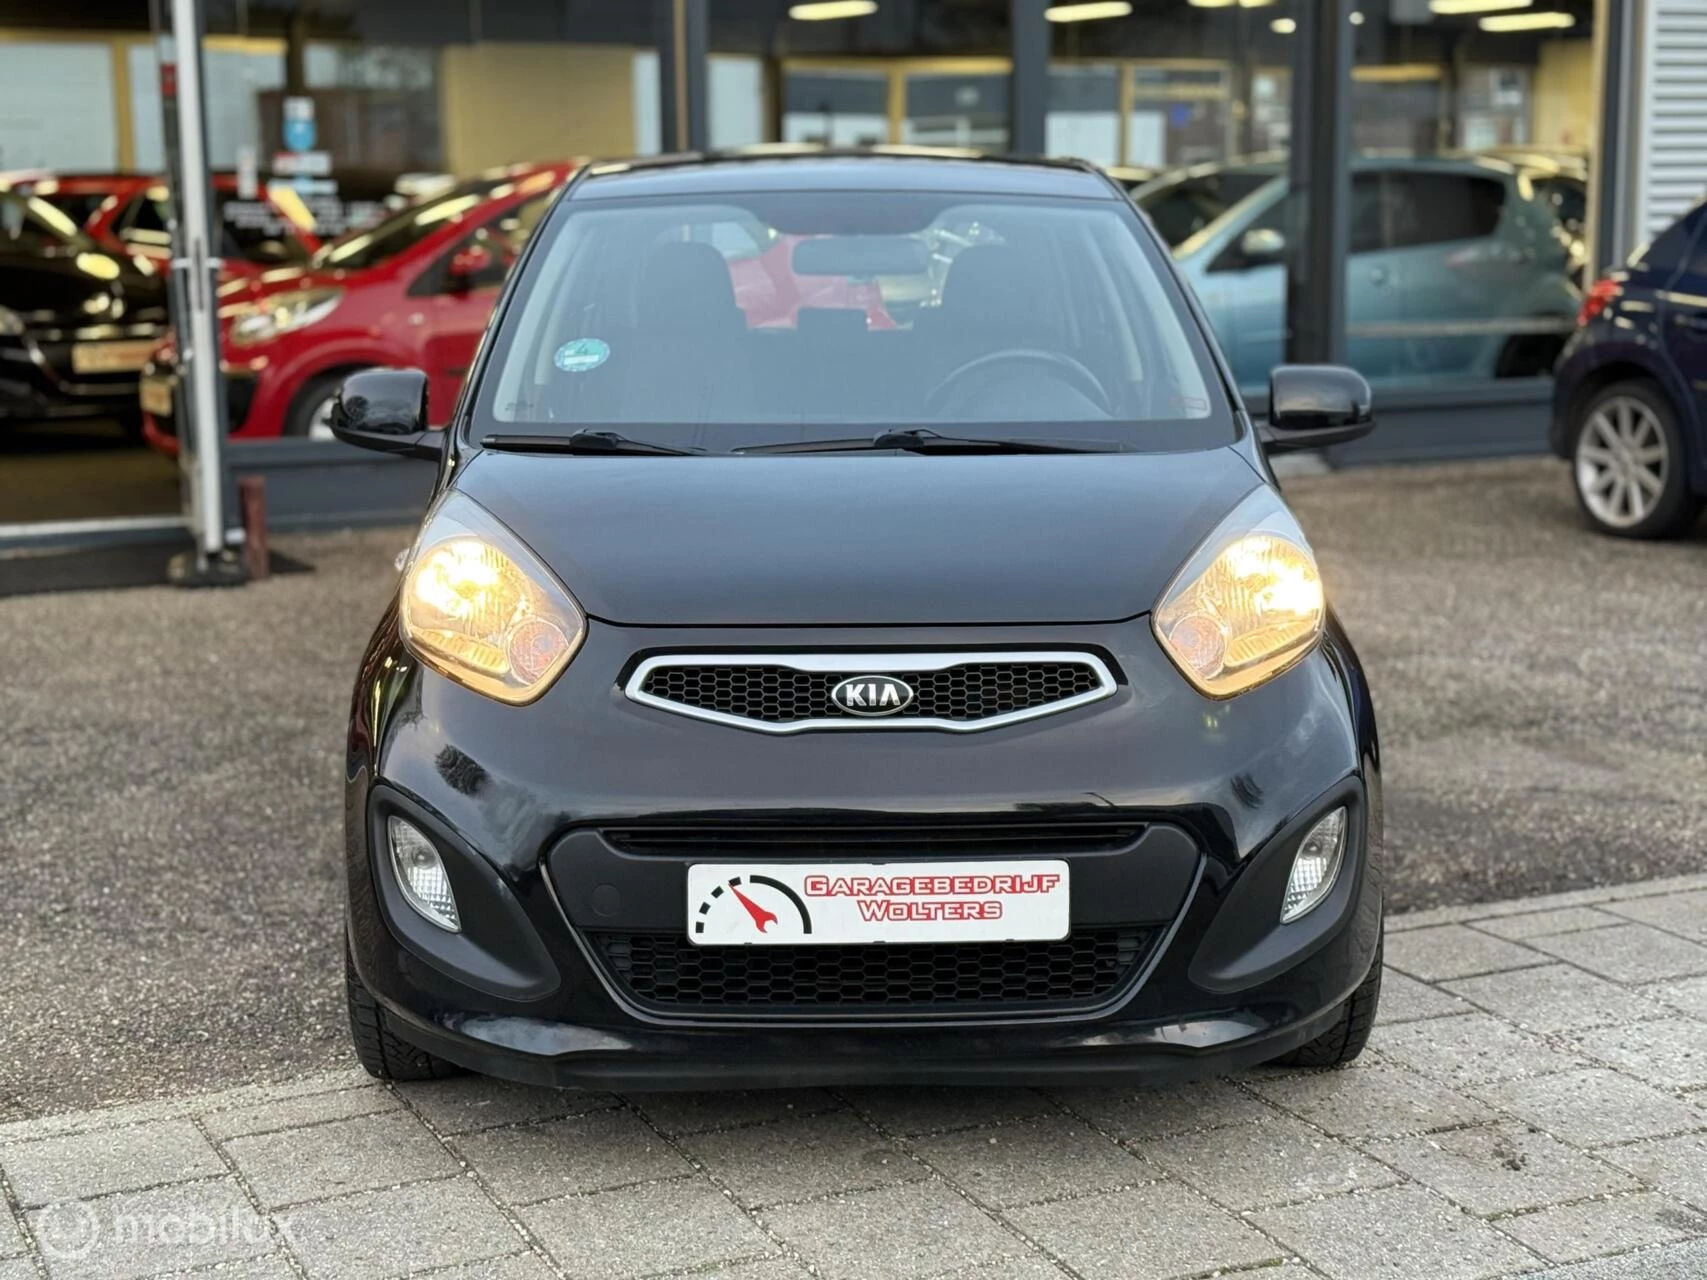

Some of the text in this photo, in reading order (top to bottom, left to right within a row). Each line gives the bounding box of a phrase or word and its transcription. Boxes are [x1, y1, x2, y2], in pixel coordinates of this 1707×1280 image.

[845, 683, 901, 706] KIA
[804, 874, 1061, 896] GARAGEBEDRIJF
[857, 899, 1003, 921] WOLTERS
